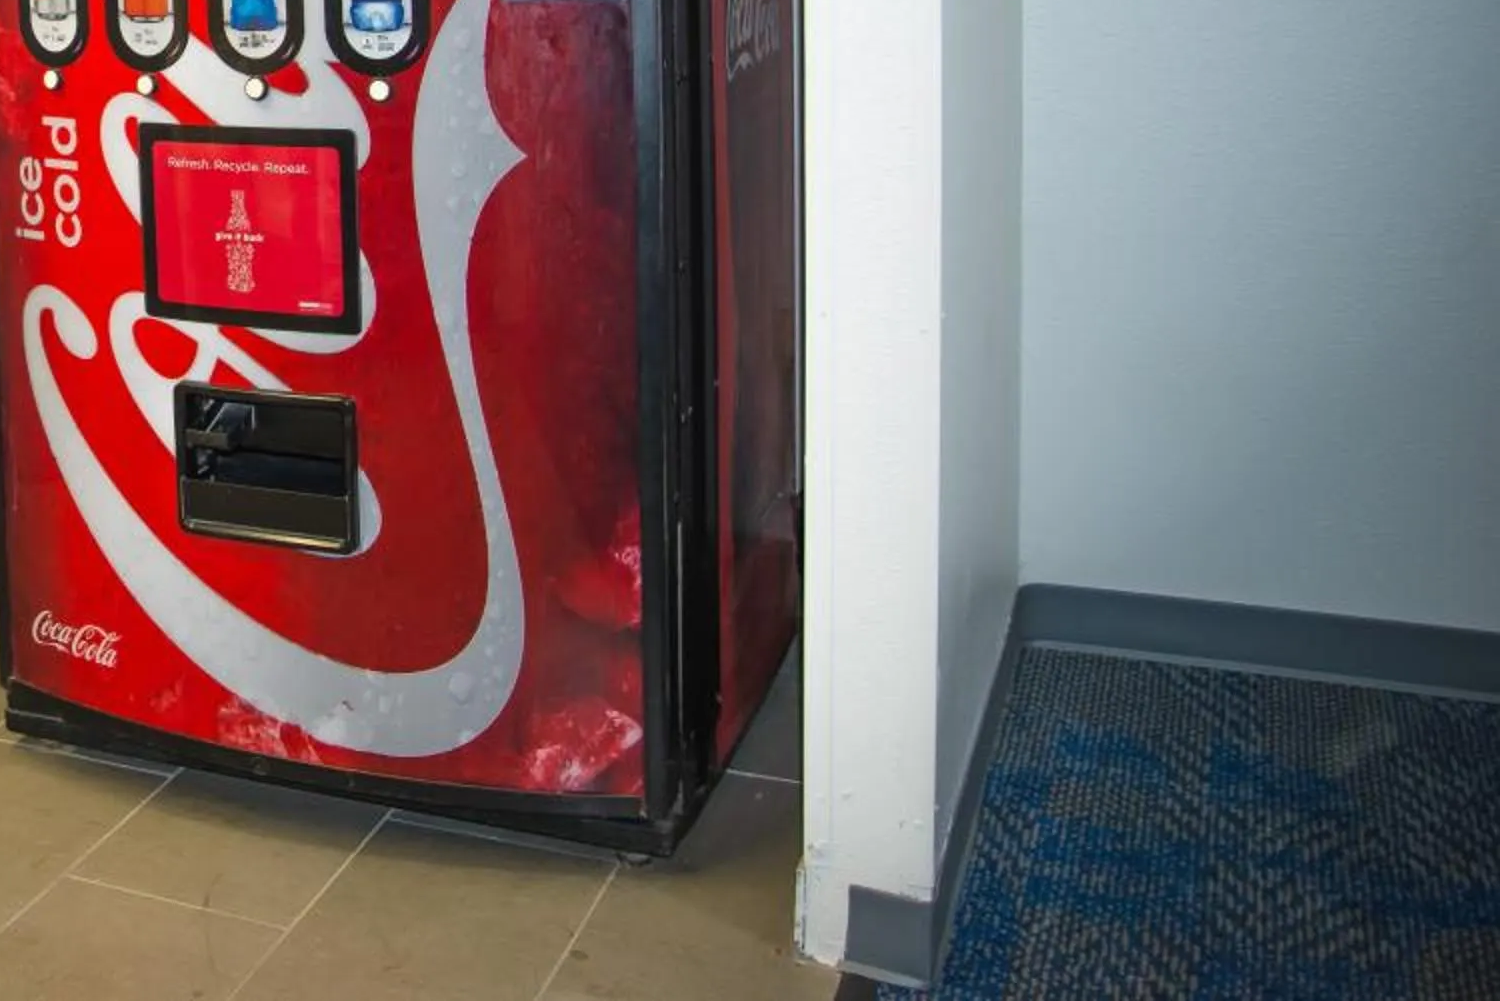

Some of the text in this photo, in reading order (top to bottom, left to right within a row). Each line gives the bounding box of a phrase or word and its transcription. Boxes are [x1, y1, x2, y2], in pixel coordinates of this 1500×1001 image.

[14, 156, 46, 241] ice
[41, 115, 84, 248] cold
[167, 156, 211, 171] Refresh.
[263, 161, 310, 176] Repeat.
[31, 609, 123, 669] Coca-Cola
